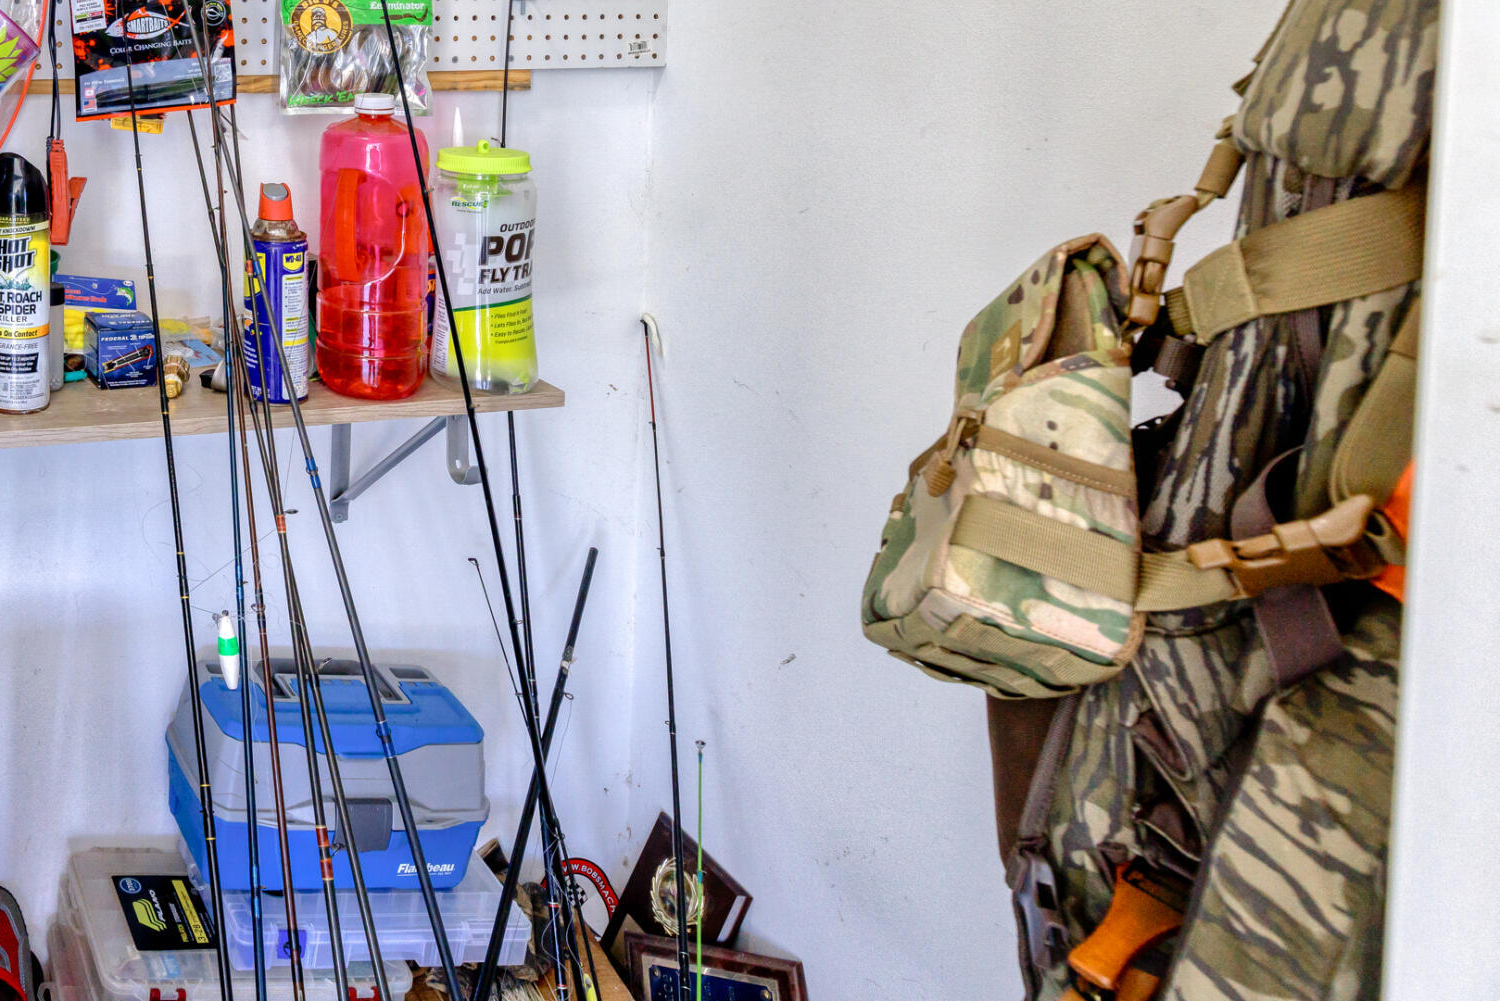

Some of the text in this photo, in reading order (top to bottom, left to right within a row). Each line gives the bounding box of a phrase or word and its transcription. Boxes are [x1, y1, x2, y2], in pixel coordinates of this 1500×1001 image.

[500, 218, 536, 232] OUTDOO
[284, 255, 302, 263] WD-40
[478, 266, 510, 284] FLY
[7, 290, 42, 304] ROACH
[14, 330, 38, 338] Contact
[396, 862, 455, 874] Flabeau
[148, 889, 166, 922] PLANO
